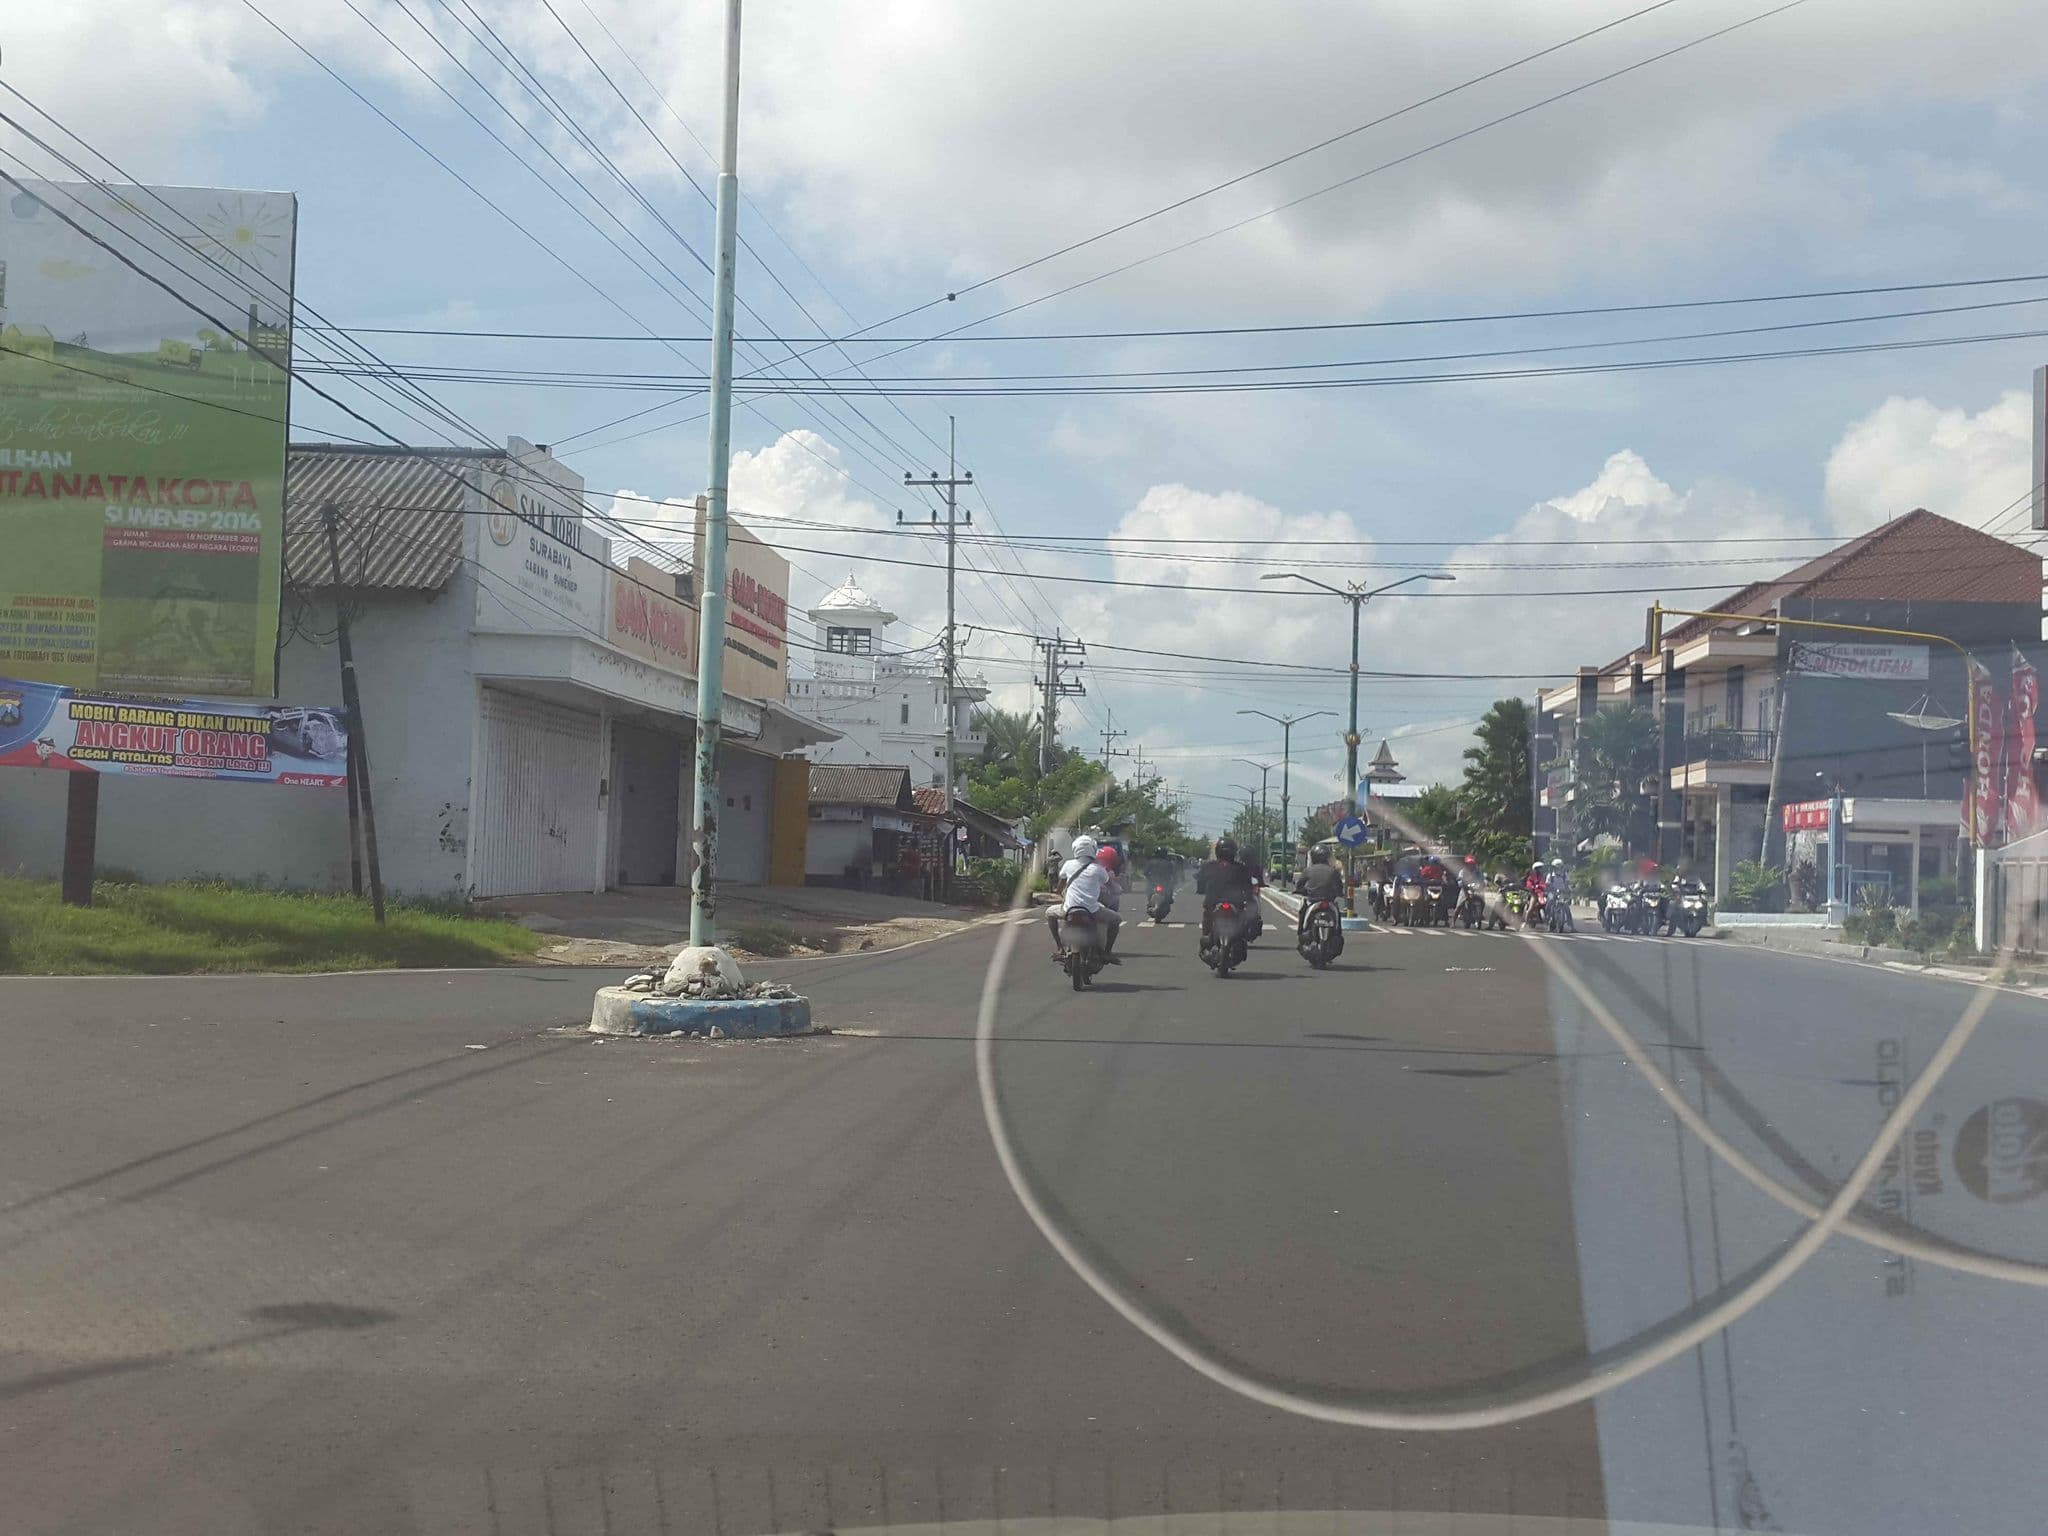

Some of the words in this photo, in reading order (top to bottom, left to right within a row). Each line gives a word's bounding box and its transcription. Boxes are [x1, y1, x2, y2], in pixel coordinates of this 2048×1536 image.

[104, 506, 206, 527] SUMENEP
[210, 511, 262, 530] 2016
[525, 559, 548, 580] CABANG
[529, 537, 572, 572] SURABAYA
[70, 703, 116, 721] MOBIL
[118, 708, 175, 726] BARANG
[177, 714, 225, 731] BUKAN
[226, 718, 271, 734] UNTUK
[75, 720, 179, 754] ANGKUT
[181, 728, 266, 760] ORANG
[1977, 685, 1994, 801] HONDA
[69, 748, 109, 760] CEGAH
[111, 751, 174, 765] FATALITAS
[175, 756, 225, 769] KORBAN
[226, 759, 256, 771] LAKA
